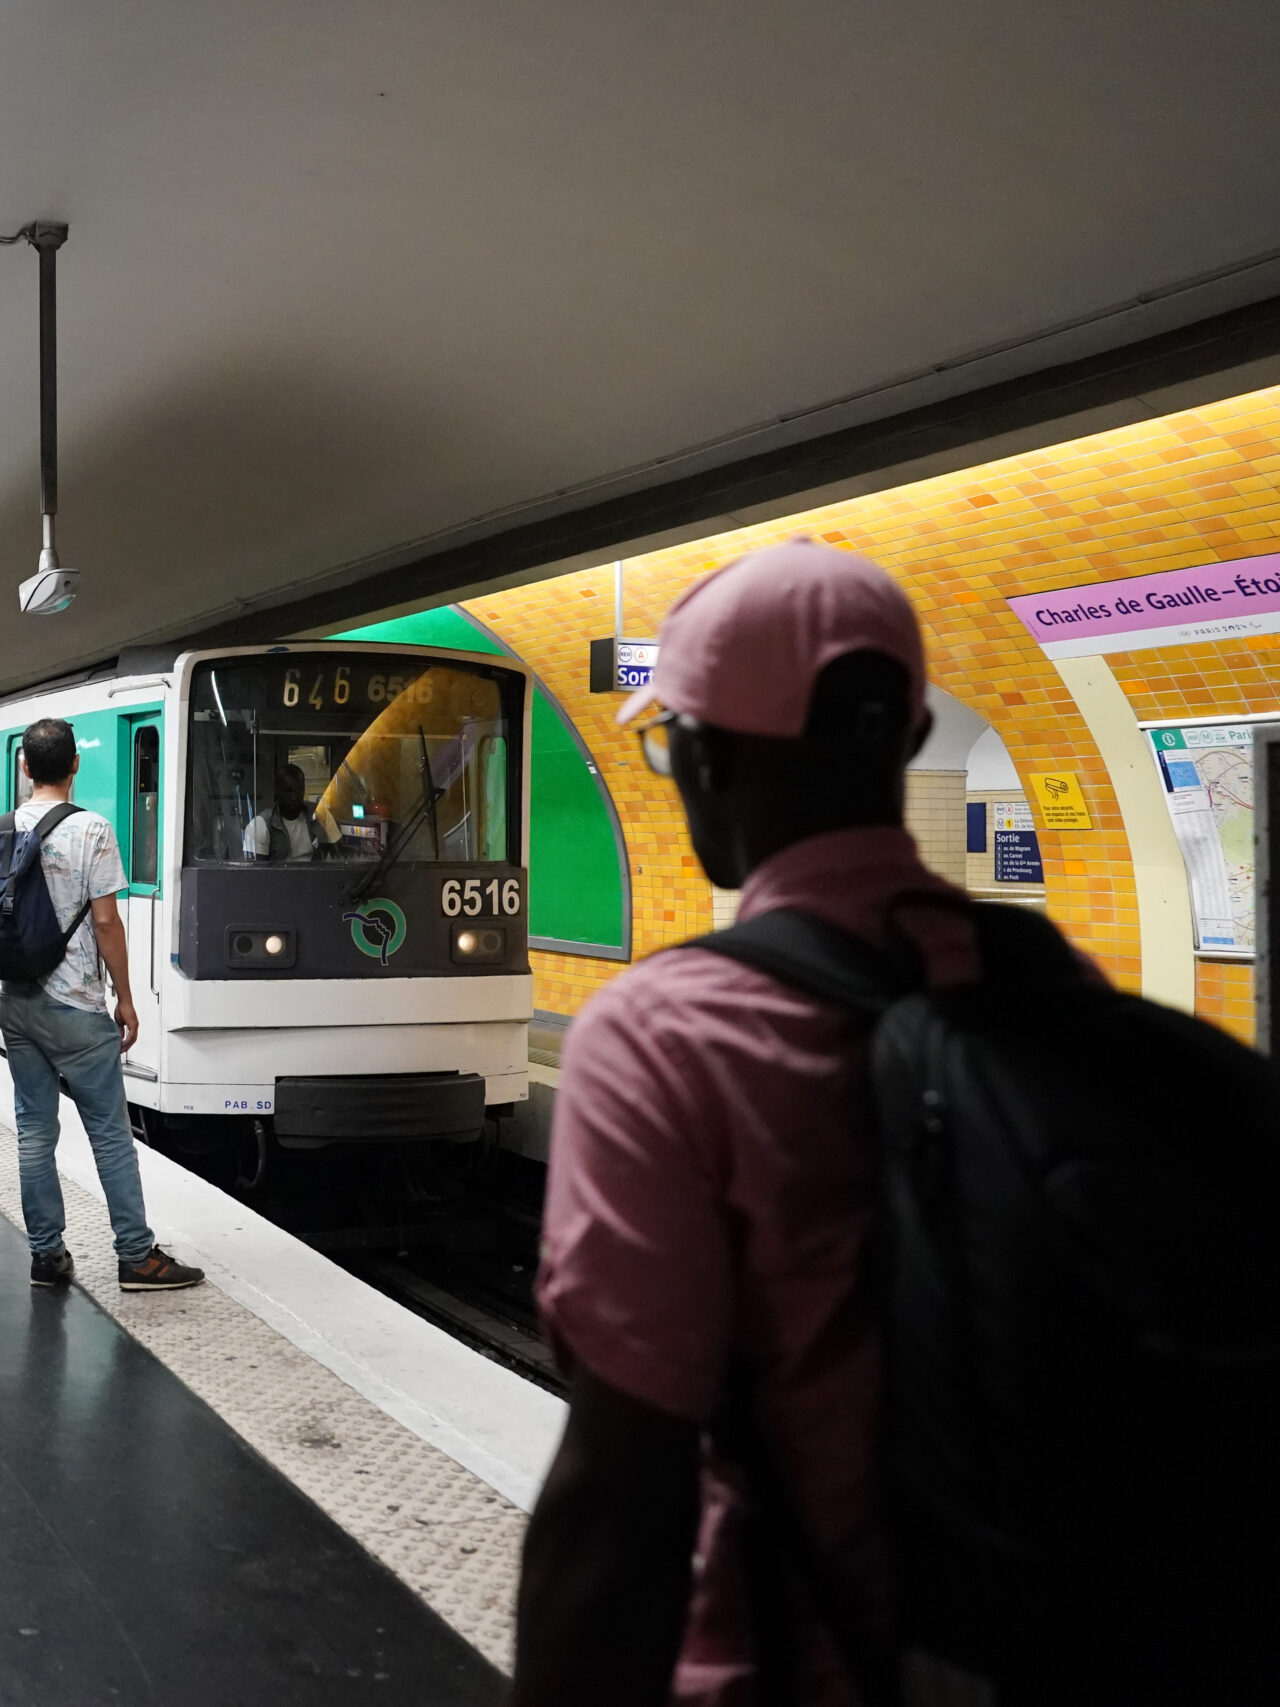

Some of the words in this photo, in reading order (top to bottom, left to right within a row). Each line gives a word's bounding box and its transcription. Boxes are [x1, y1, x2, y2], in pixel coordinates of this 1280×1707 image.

[1036, 604, 1112, 626] Charles
[1115, 598, 1144, 616] de
[1194, 626, 1221, 635] PARIS
[1222, 624, 1247, 632] 2024
[638, 650, 644, 658] A
[996, 833, 1020, 843] Sortie
[442, 879, 520, 916] 6516
[224, 1100, 248, 1109] PAB
[256, 1101, 272, 1110] SD
